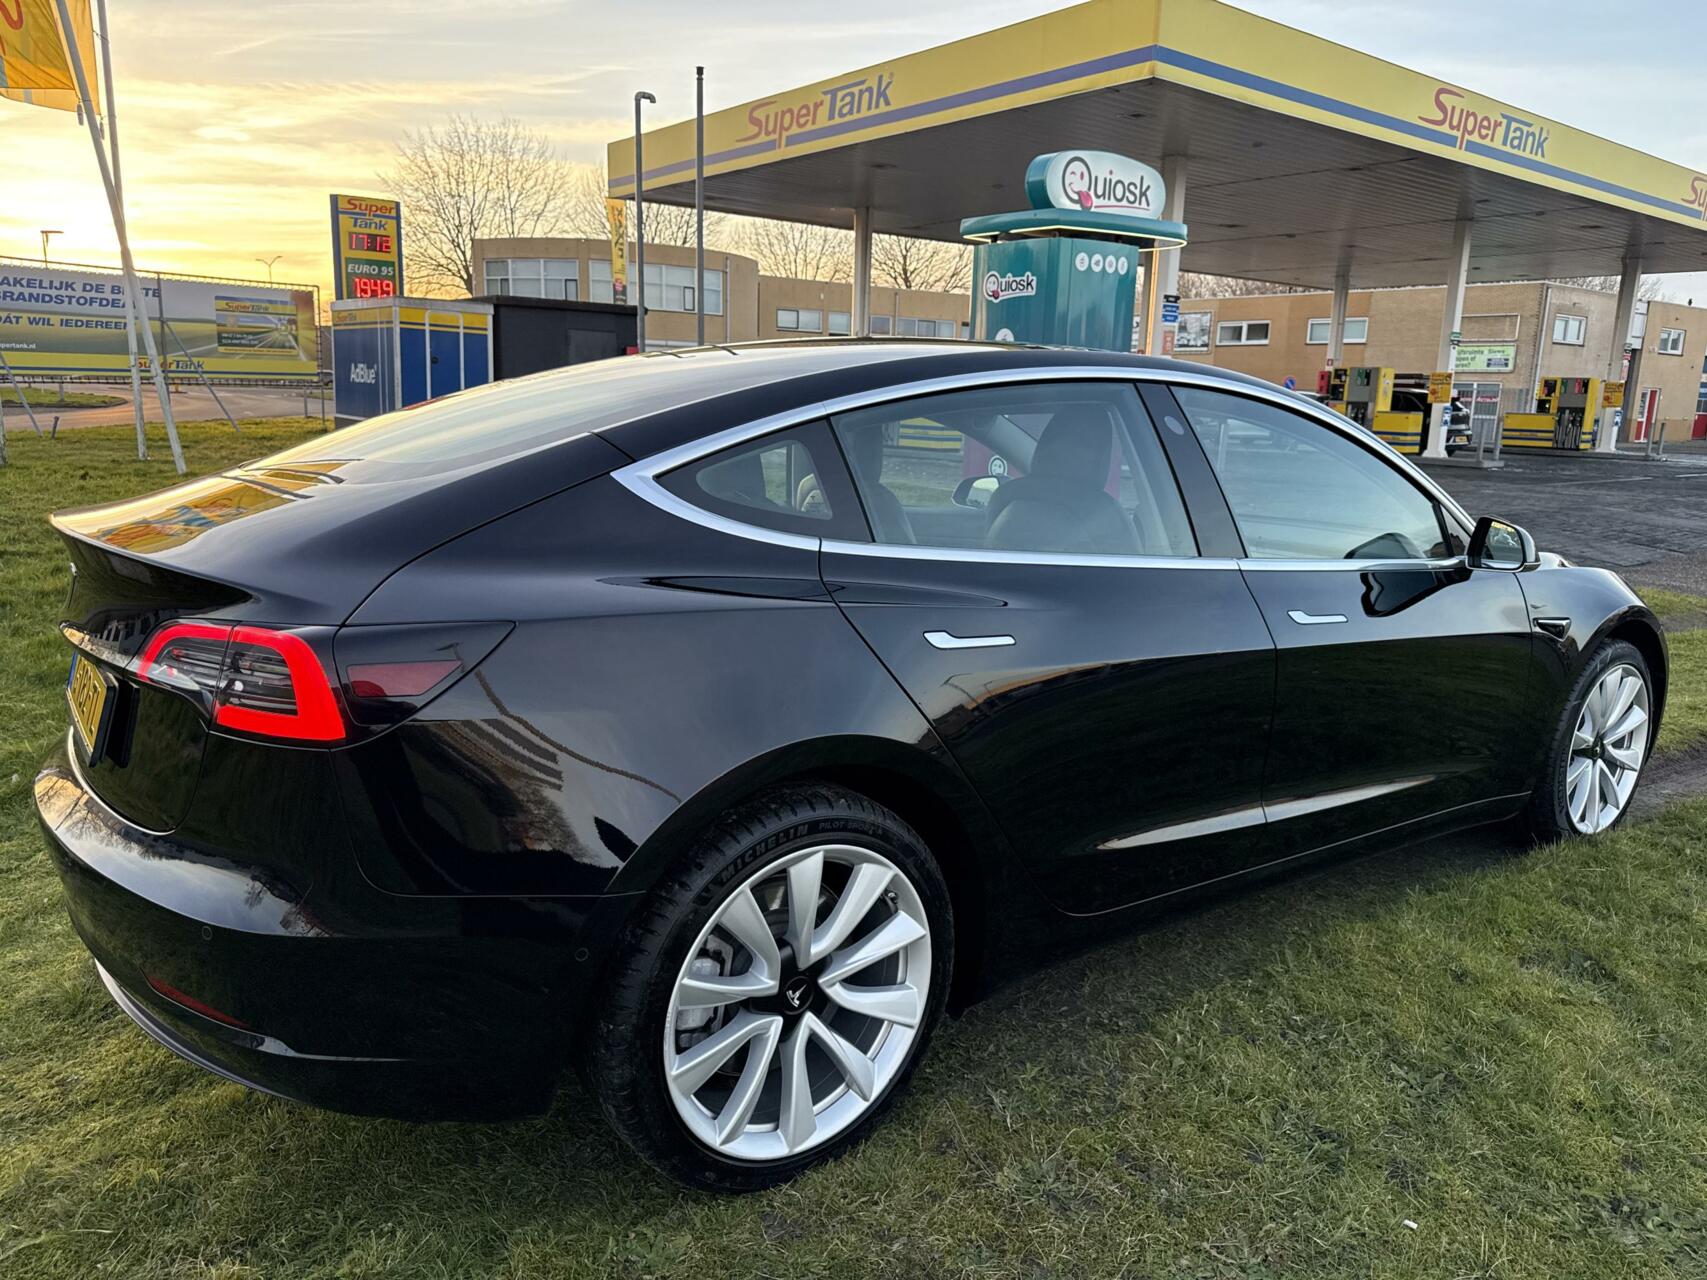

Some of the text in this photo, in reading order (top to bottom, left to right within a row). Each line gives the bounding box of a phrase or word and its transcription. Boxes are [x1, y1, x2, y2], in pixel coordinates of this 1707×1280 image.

[736, 74, 893, 150] SuperTank
[1418, 87, 1549, 158] SuperTank
[1062, 156, 1151, 209] Quiosk
[341, 198, 395, 217] Super
[1680, 176, 1707, 221] Su
[348, 216, 388, 231] Tank
[351, 234, 392, 252] 17:12
[348, 264, 394, 276] EURO 95
[0, 276, 77, 292] AKELIJK
[82, 282, 105, 294] DE
[985, 274, 1034, 299] Quiosk
[0, 312, 23, 325] ÁT
[28, 316, 55, 327] WIL
[720, 824, 809, 883] MICHELIN
